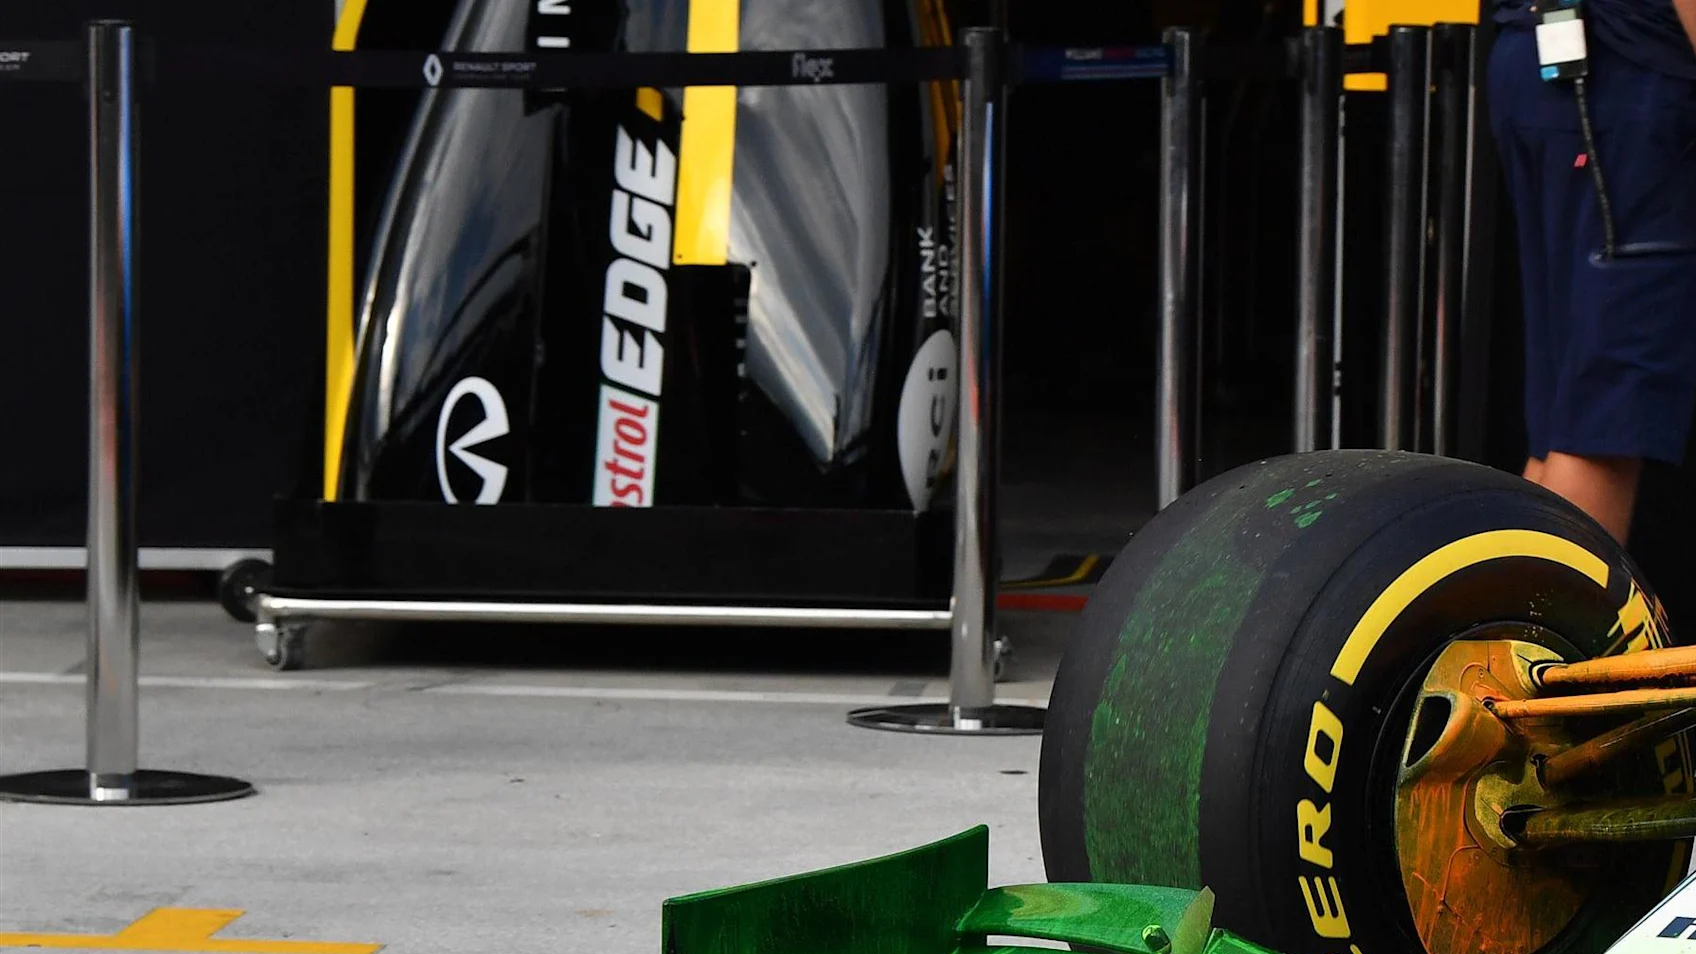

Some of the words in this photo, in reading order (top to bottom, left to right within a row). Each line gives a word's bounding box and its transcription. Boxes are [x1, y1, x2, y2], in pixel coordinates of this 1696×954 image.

[600, 124, 677, 397] EDGE
[917, 227, 937, 319] BANK
[605, 398, 649, 507] strol
